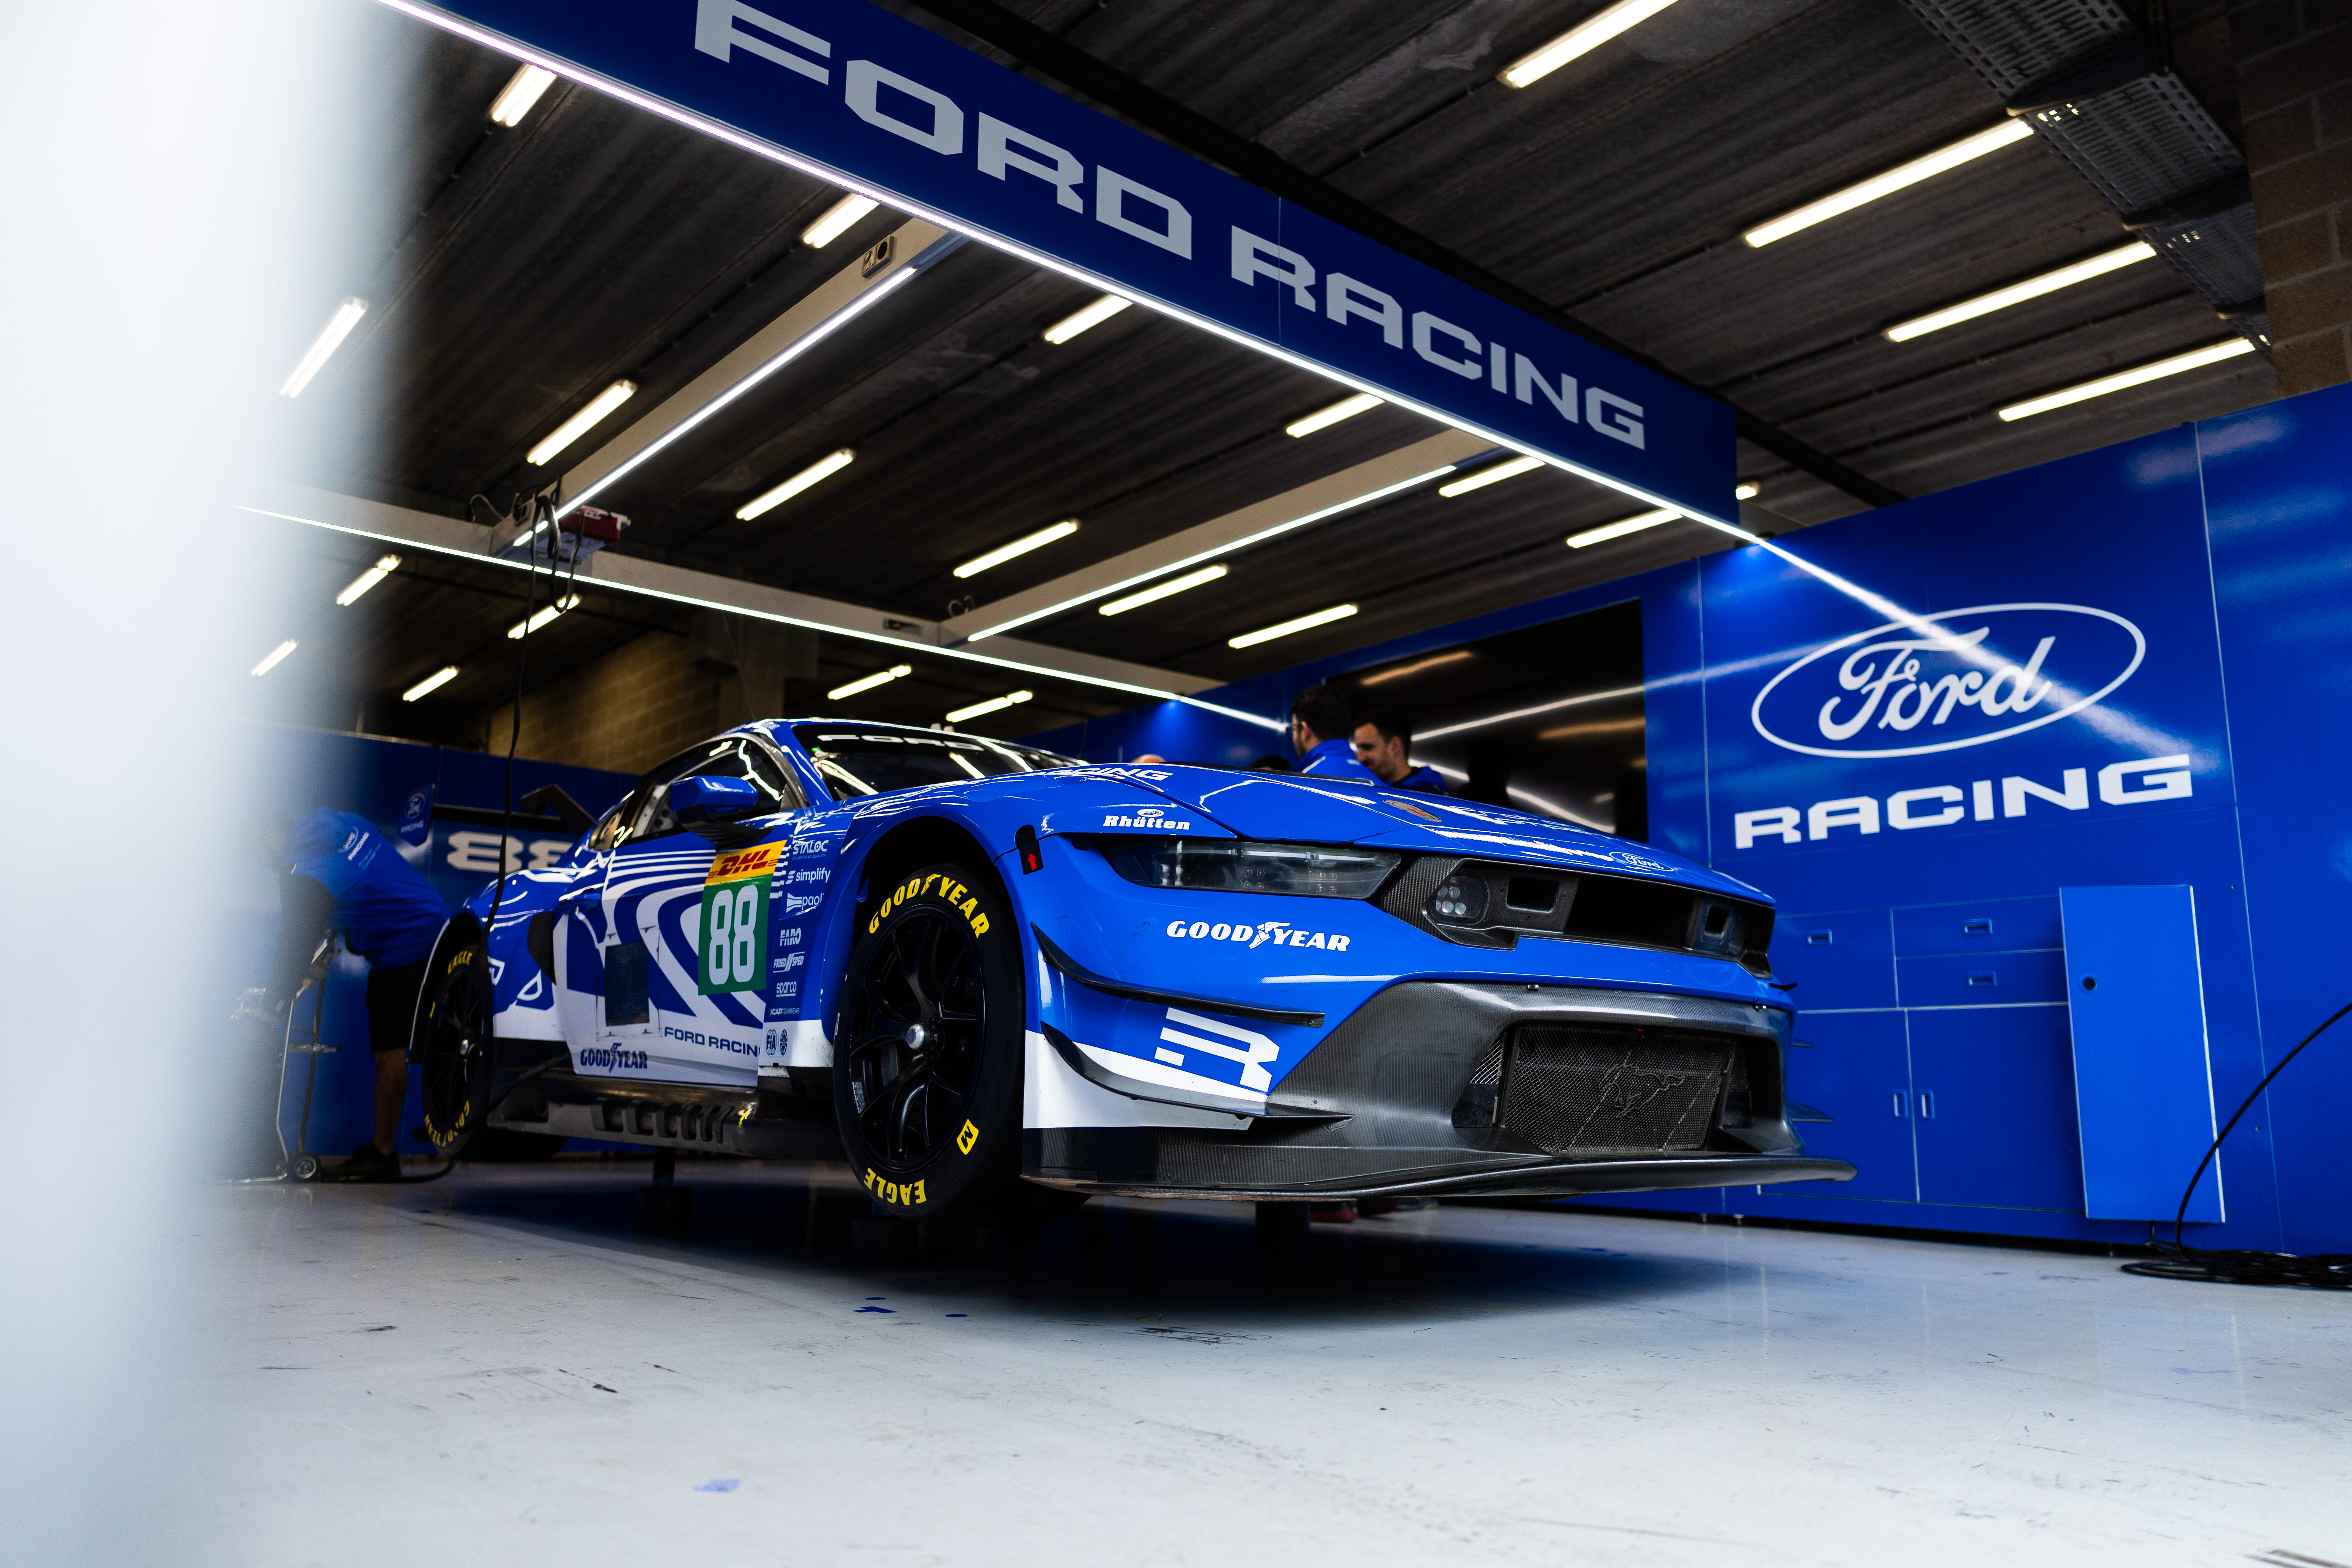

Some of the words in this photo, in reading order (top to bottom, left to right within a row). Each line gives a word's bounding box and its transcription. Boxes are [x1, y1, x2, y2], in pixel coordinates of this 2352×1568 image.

[695, 0, 1192, 260] FORD
[1232, 225, 1645, 450] RACING
[1818, 626, 2056, 741] Ford
[817, 735, 984, 751] FORD
[1734, 754, 2192, 849] RACING
[1103, 815, 1190, 830] Rhütten
[793, 840, 829, 855] STALOC
[717, 849, 771, 876] DHL
[1621, 854, 1664, 869] Ford
[796, 867, 831, 884] simplify
[802, 893, 824, 911] paol
[869, 874, 990, 939] GOODYEAR
[709, 884, 758, 985] 88
[780, 927, 801, 946] FARO
[1167, 920, 1350, 952] GOODYEAR
[448, 950, 473, 975] EAGLE
[776, 981, 797, 998] sparco
[664, 1026, 705, 1045] FORD
[708, 1036, 760, 1057] RACIN
[581, 1043, 648, 1073] GOODYEAR
[864, 1167, 926, 1205] EAGLE
